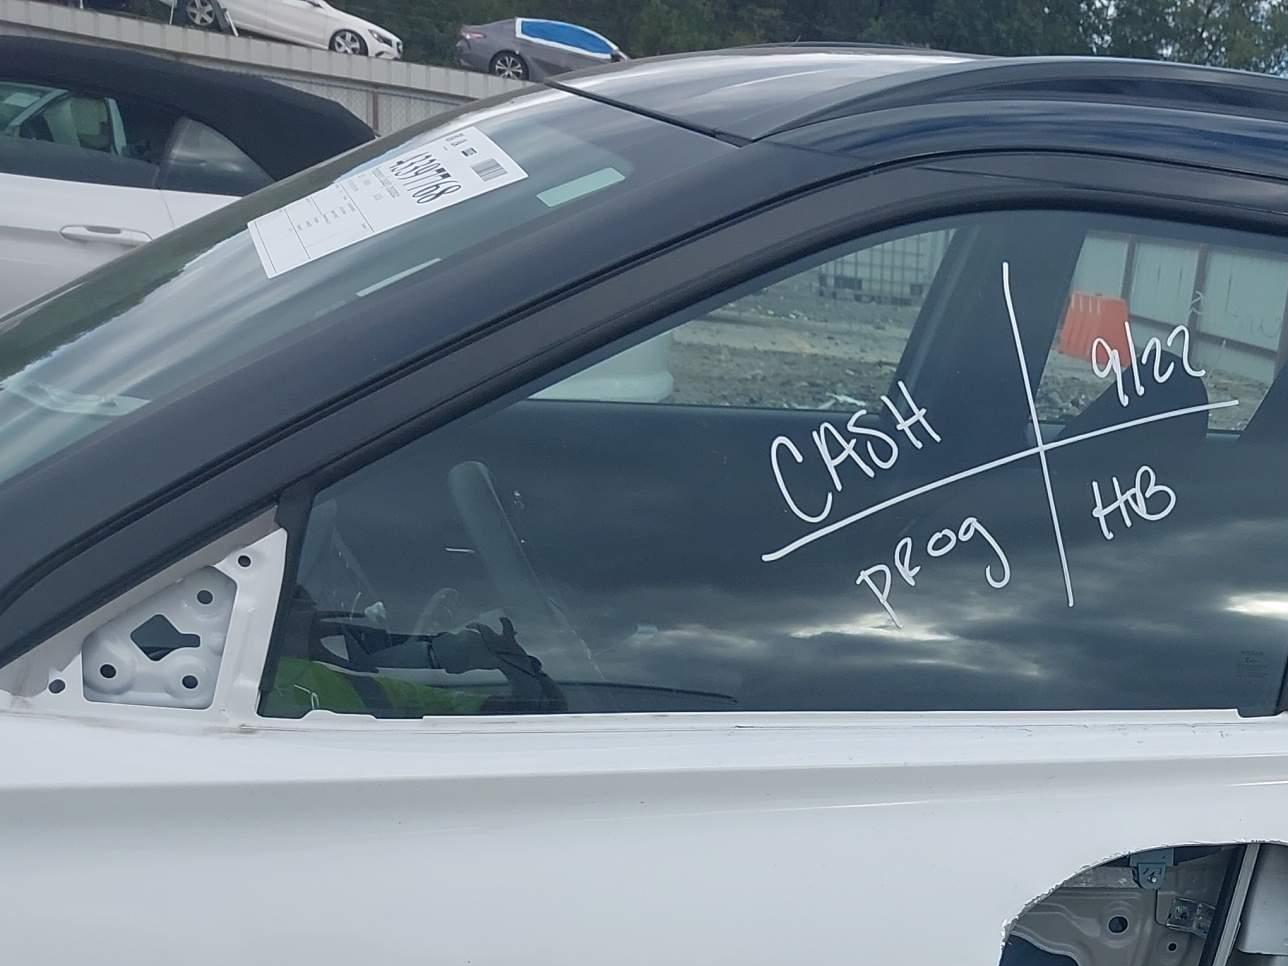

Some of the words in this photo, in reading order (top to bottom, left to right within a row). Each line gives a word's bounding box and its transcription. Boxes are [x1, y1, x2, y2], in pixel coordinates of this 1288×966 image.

[1091, 321, 1206, 408] 9/22
[770, 379, 942, 523] CASH
[1092, 465, 1177, 540] HB
